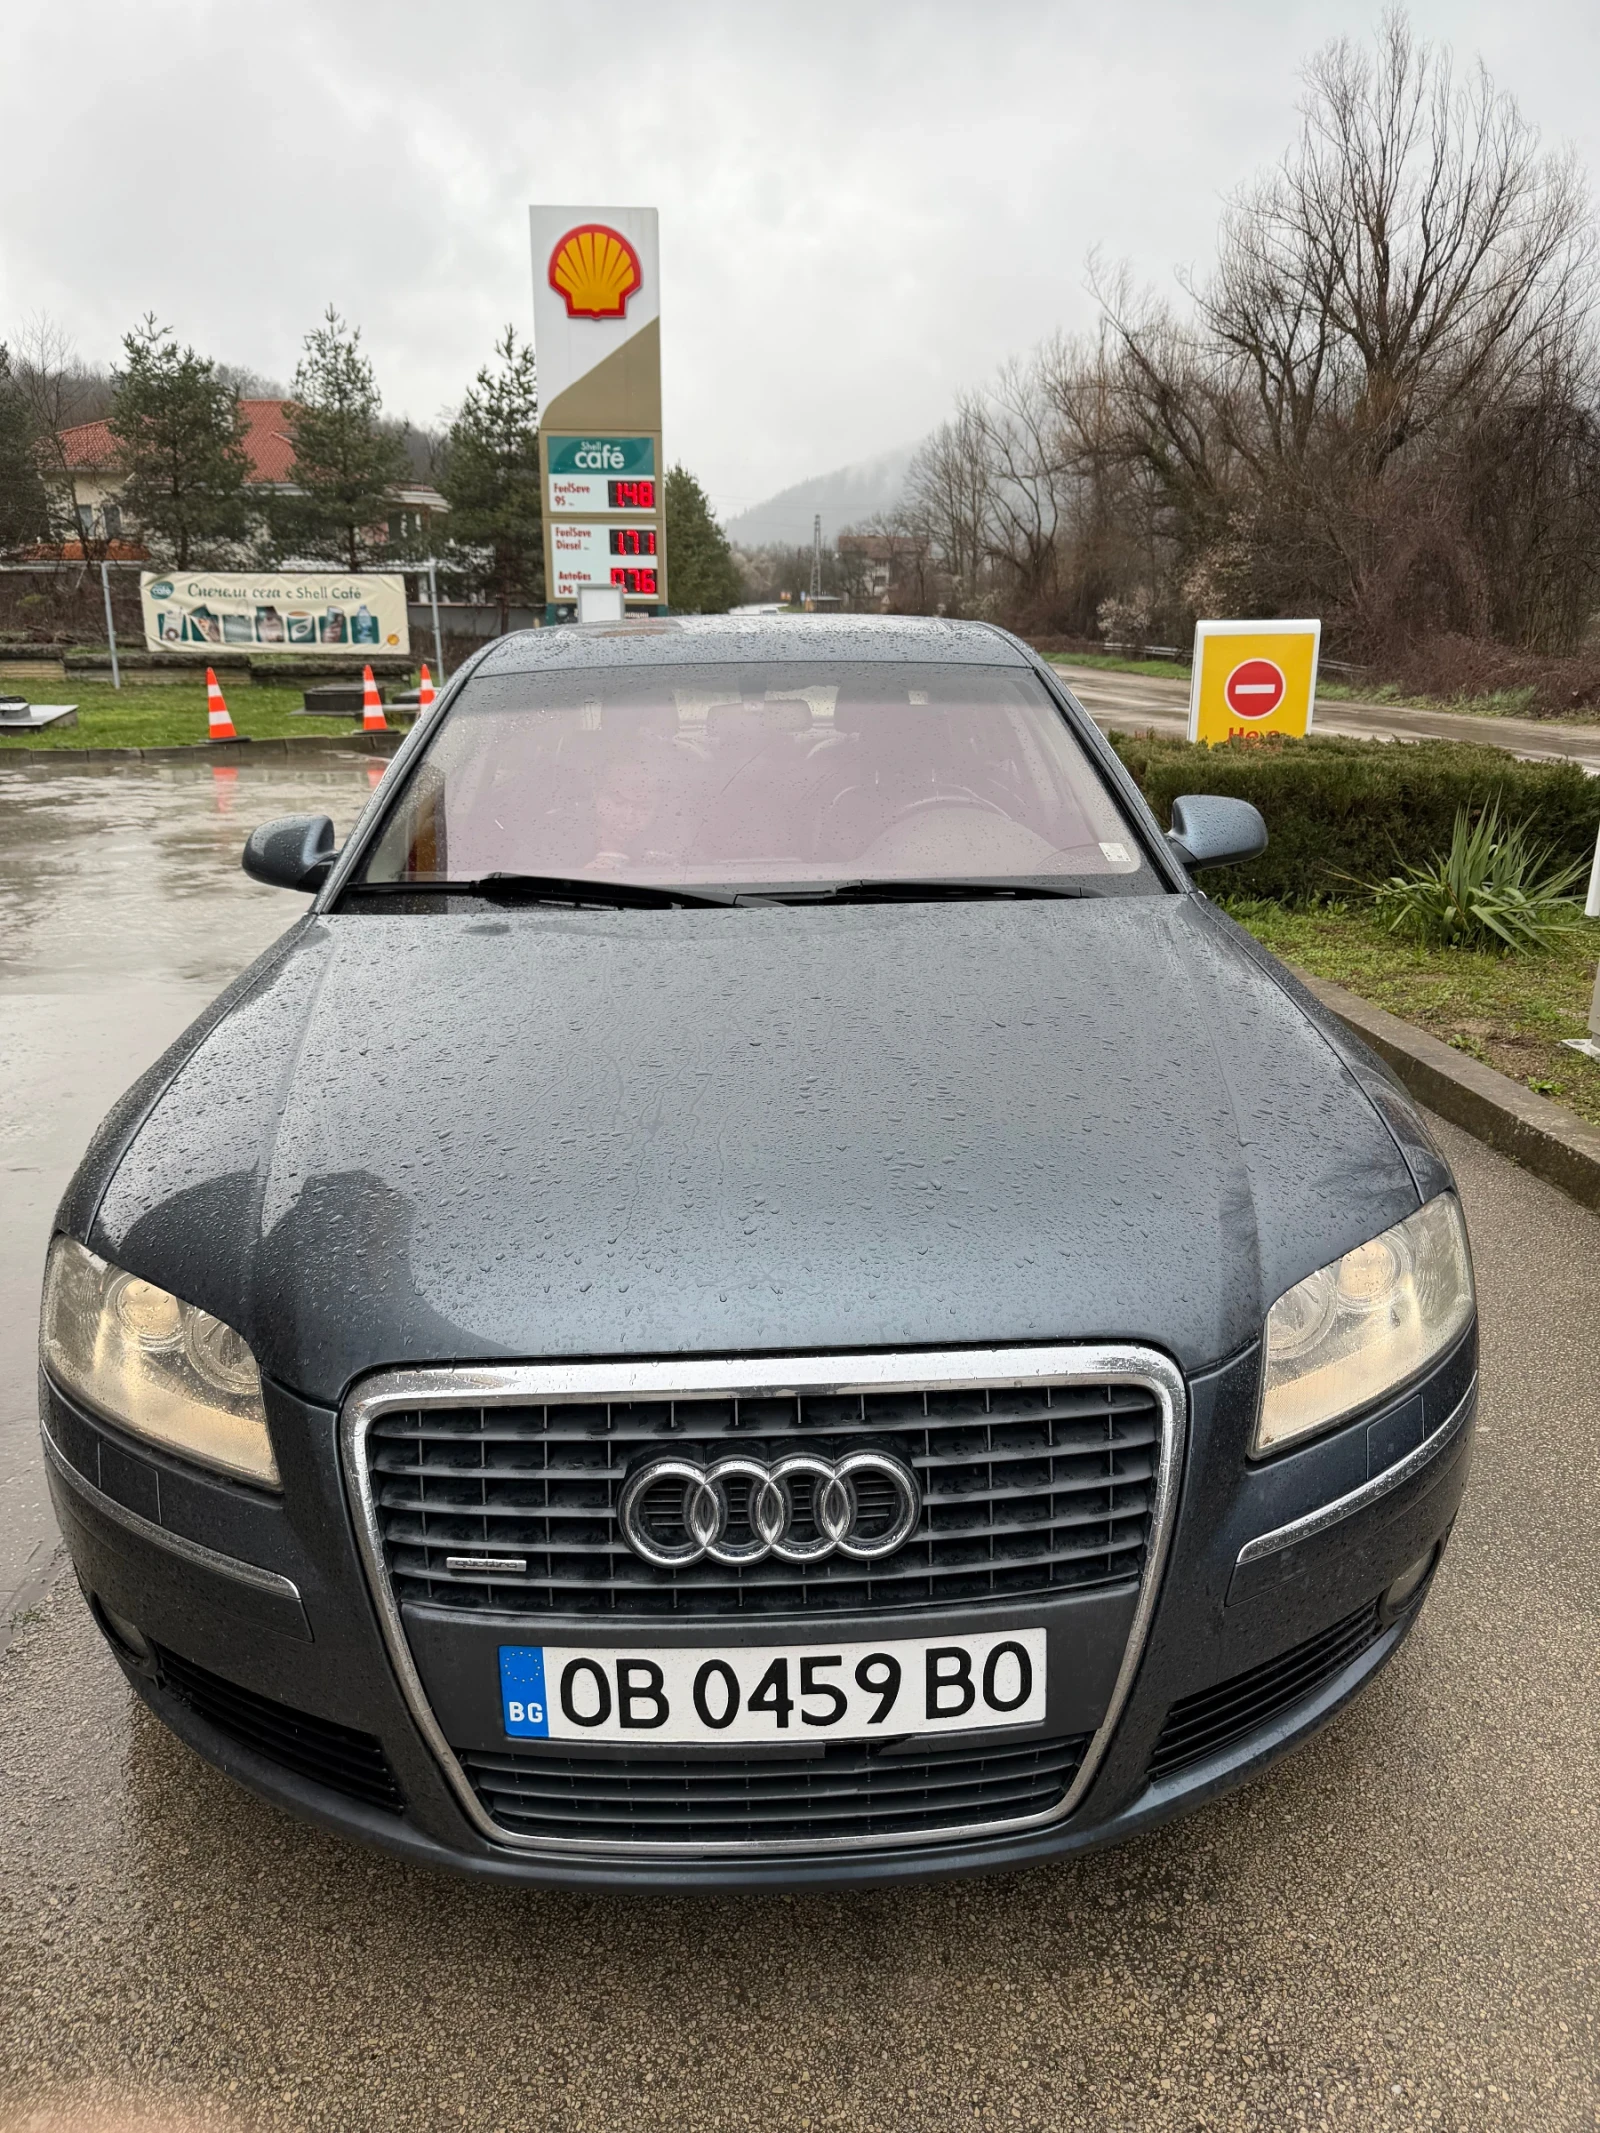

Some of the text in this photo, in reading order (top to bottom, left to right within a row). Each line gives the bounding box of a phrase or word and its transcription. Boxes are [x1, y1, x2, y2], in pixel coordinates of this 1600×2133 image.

[581, 441, 602, 451] Shell
[574, 444, 625, 469] café
[554, 482, 590, 494] FuelSave
[554, 496, 566, 506] 95
[555, 527, 591, 538] FuelSave
[556, 540, 581, 550] Diesel
[558, 571, 591, 581] AutoGas
[296, 586, 328, 599] Shell
[331, 586, 362, 599] Café
[558, 585, 573, 594] LPG
[560, 1641, 1032, 1729] OB 0459 BO
[509, 1701, 543, 1723] BG
